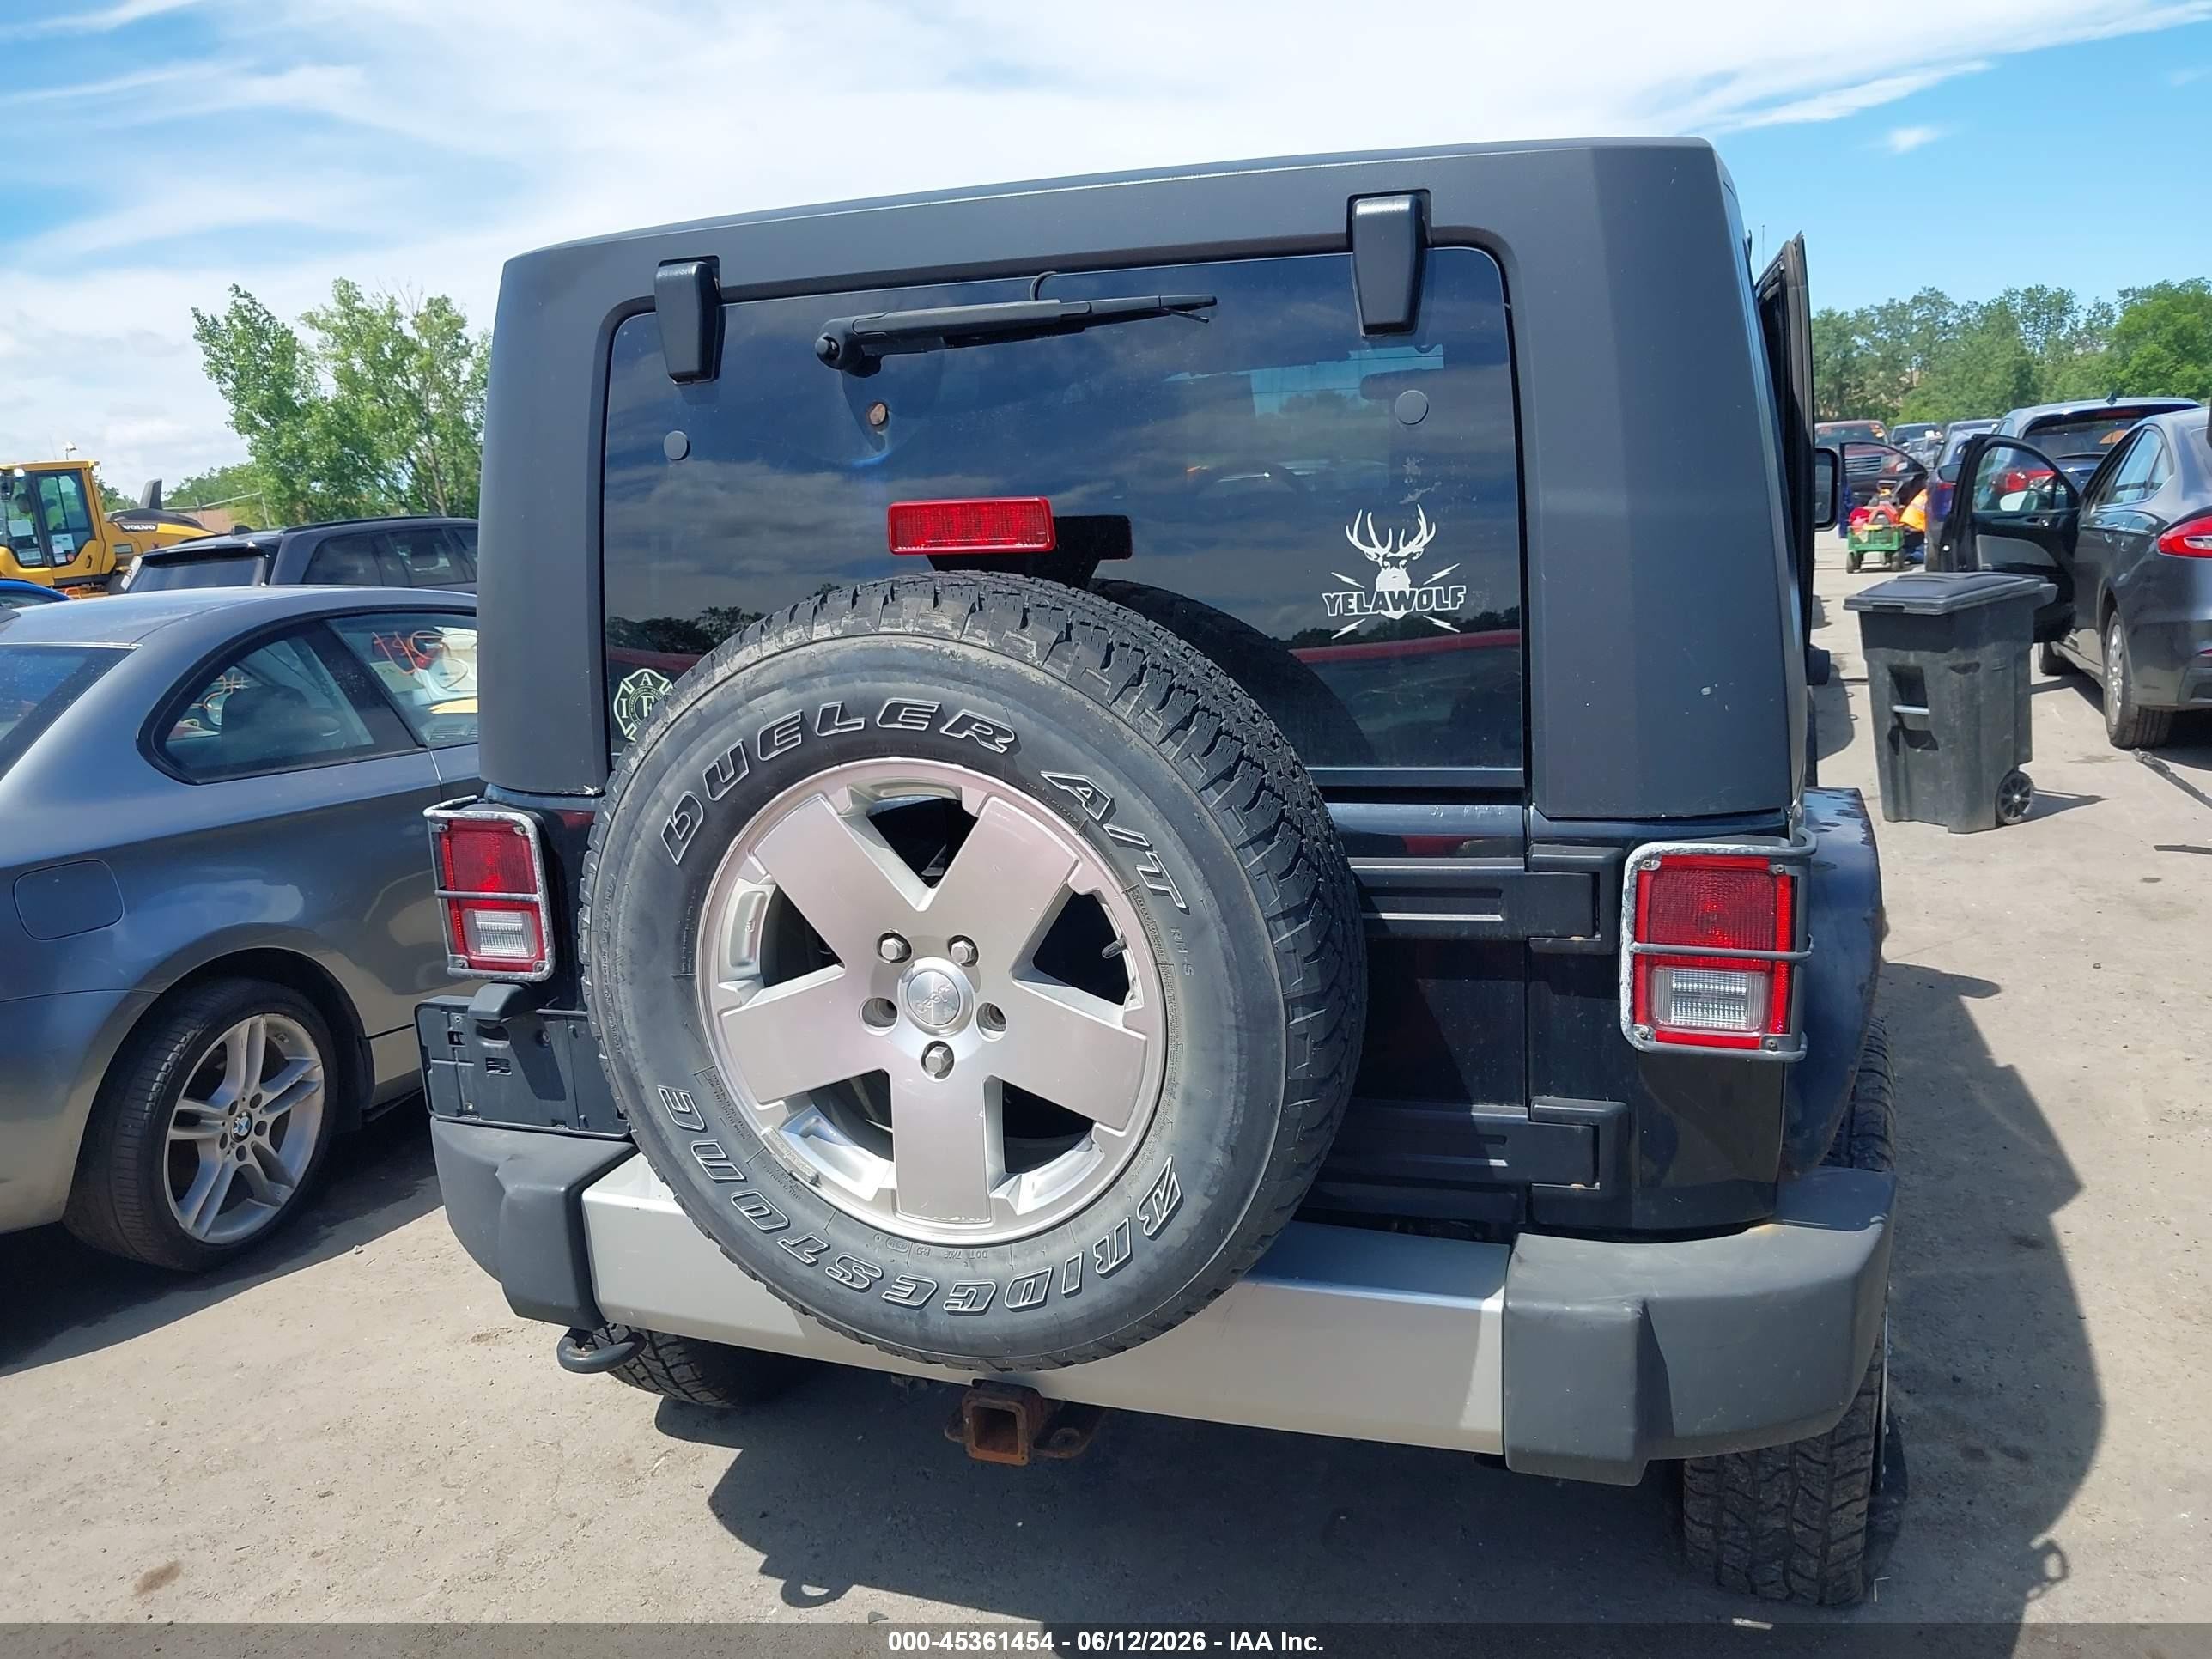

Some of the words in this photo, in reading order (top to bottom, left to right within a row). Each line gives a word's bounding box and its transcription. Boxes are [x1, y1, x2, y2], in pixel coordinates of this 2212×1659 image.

[1322, 585, 1467, 617] YELAWOLF
[660, 697, 1016, 865] DUELER
[1040, 770, 1188, 909] A/T
[1169, 927, 1194, 976] RH-S
[656, 1085, 1184, 1318] BRIDGESTONE
